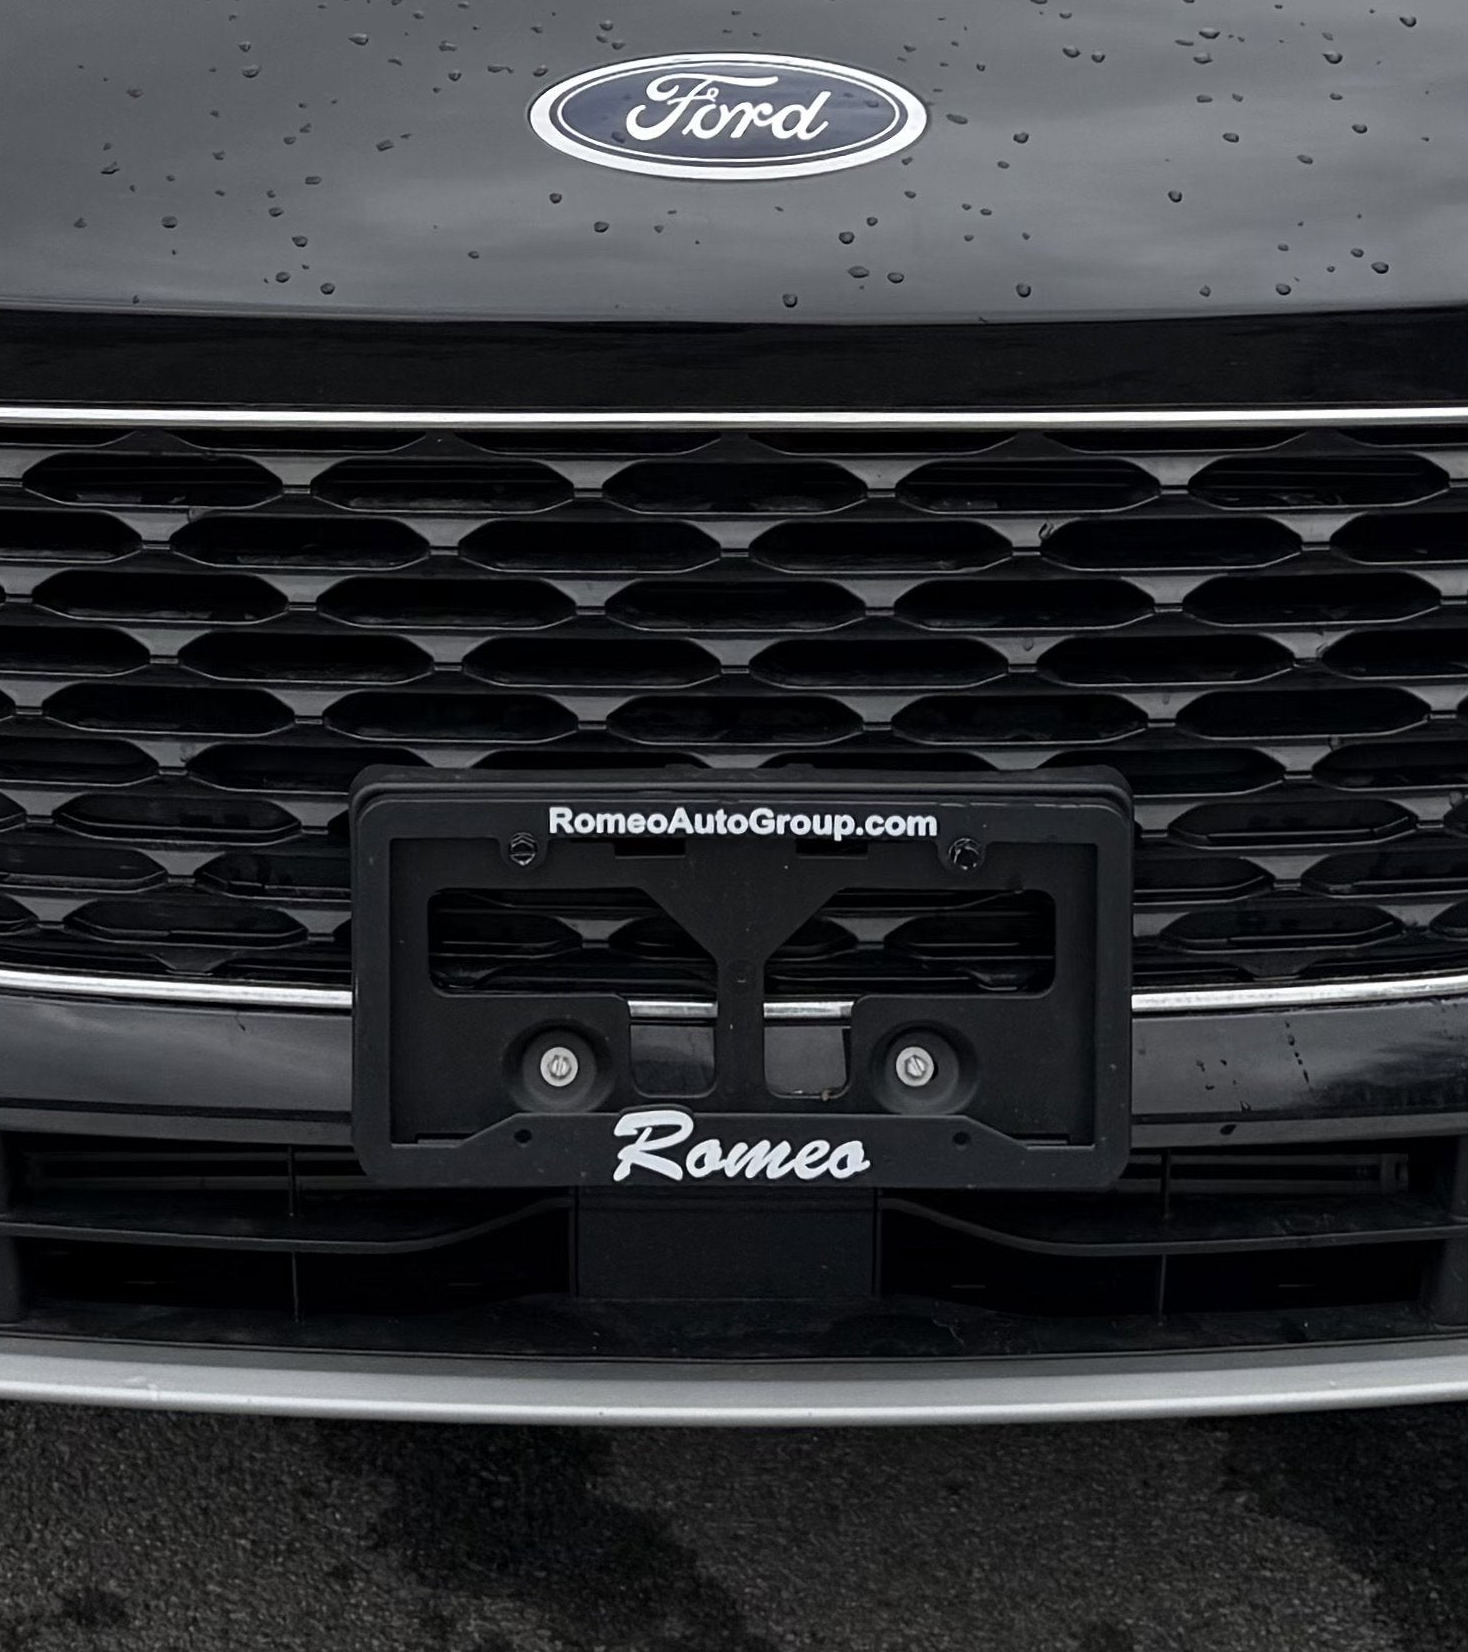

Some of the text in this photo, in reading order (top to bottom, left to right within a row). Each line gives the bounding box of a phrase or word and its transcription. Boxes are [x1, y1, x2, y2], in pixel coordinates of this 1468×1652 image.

[625, 72, 832, 141] Ford
[548, 806, 939, 842] RomeoAutoGroup.com
[612, 1108, 871, 1182] Romeo
